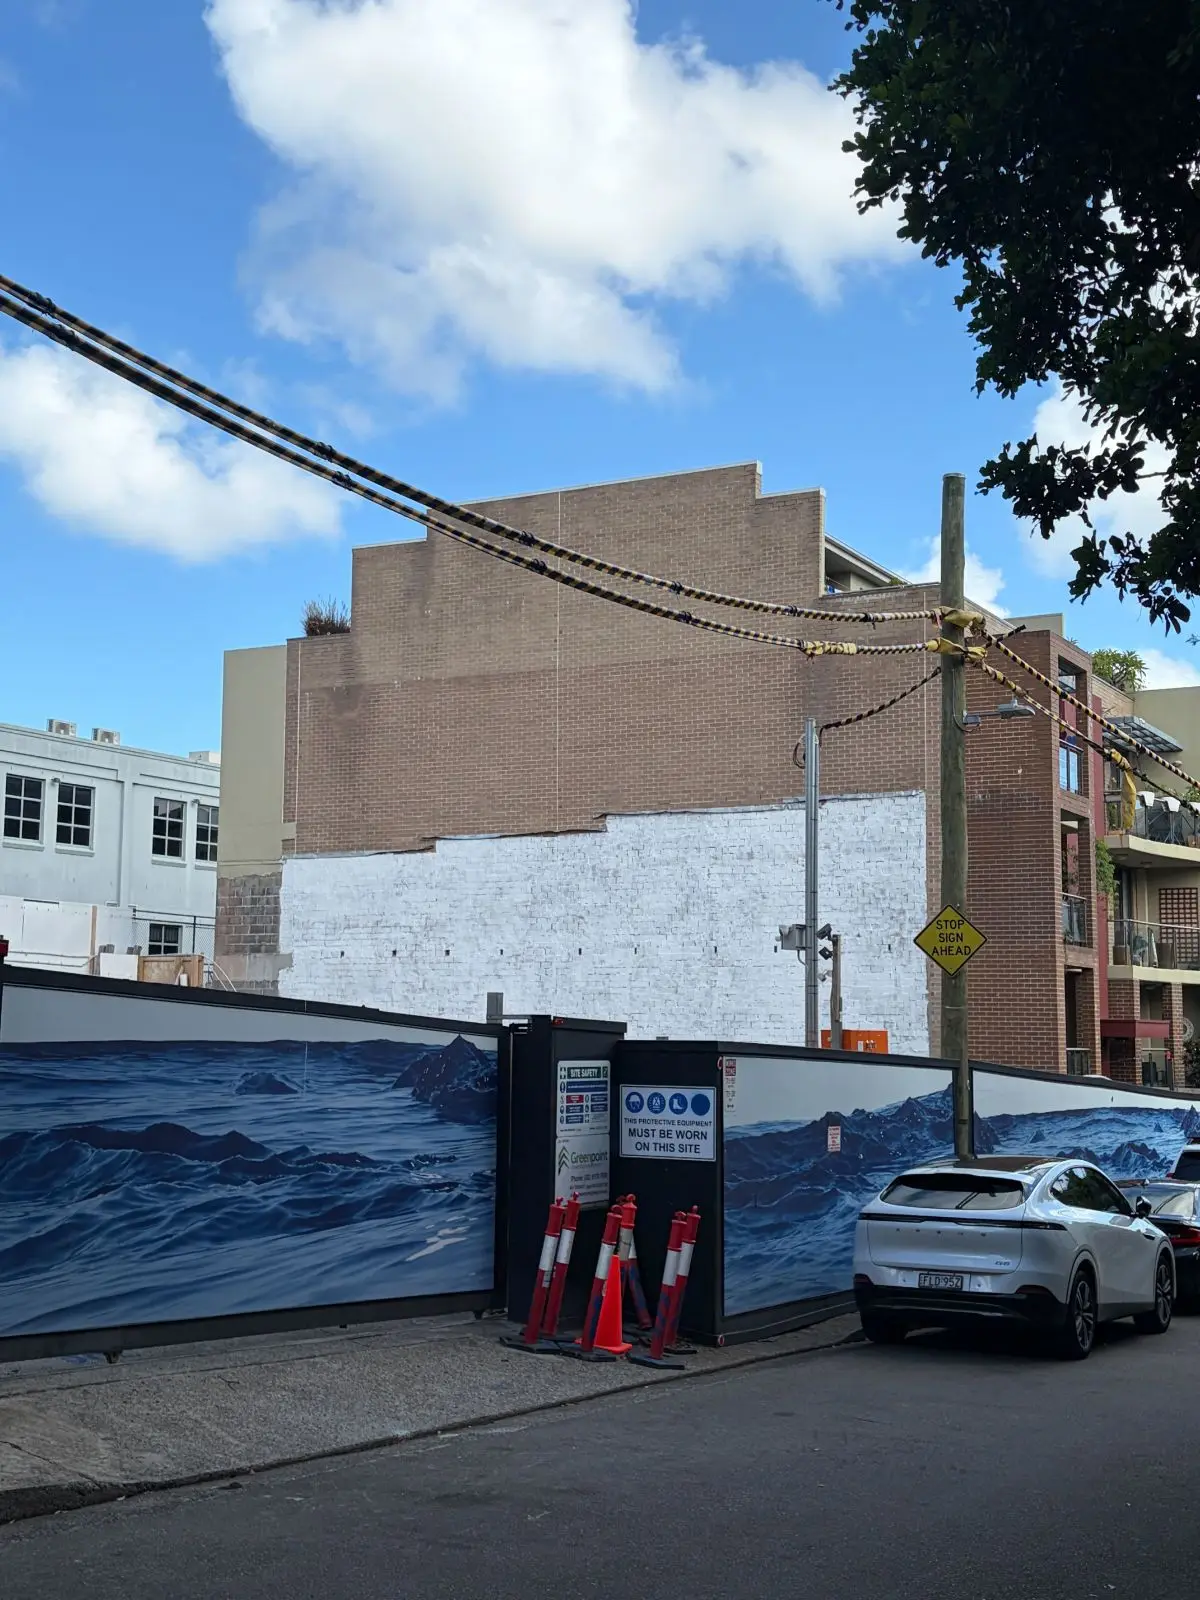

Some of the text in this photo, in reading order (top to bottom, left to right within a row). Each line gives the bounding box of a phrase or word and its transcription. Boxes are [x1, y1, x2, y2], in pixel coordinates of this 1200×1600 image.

[936, 919, 965, 930] STOP
[938, 932, 964, 943] SIGN
[931, 945, 972, 956] AHEAD
[570, 1068, 598, 1078] SITE SAFETY
[623, 1117, 713, 1127] THIS PROTECTIVE EQUIPMENT
[628, 1127, 708, 1140] MUST BE WORN
[635, 1141, 701, 1154] ON THIS SITE
[571, 1151, 608, 1164] Greenpoint
